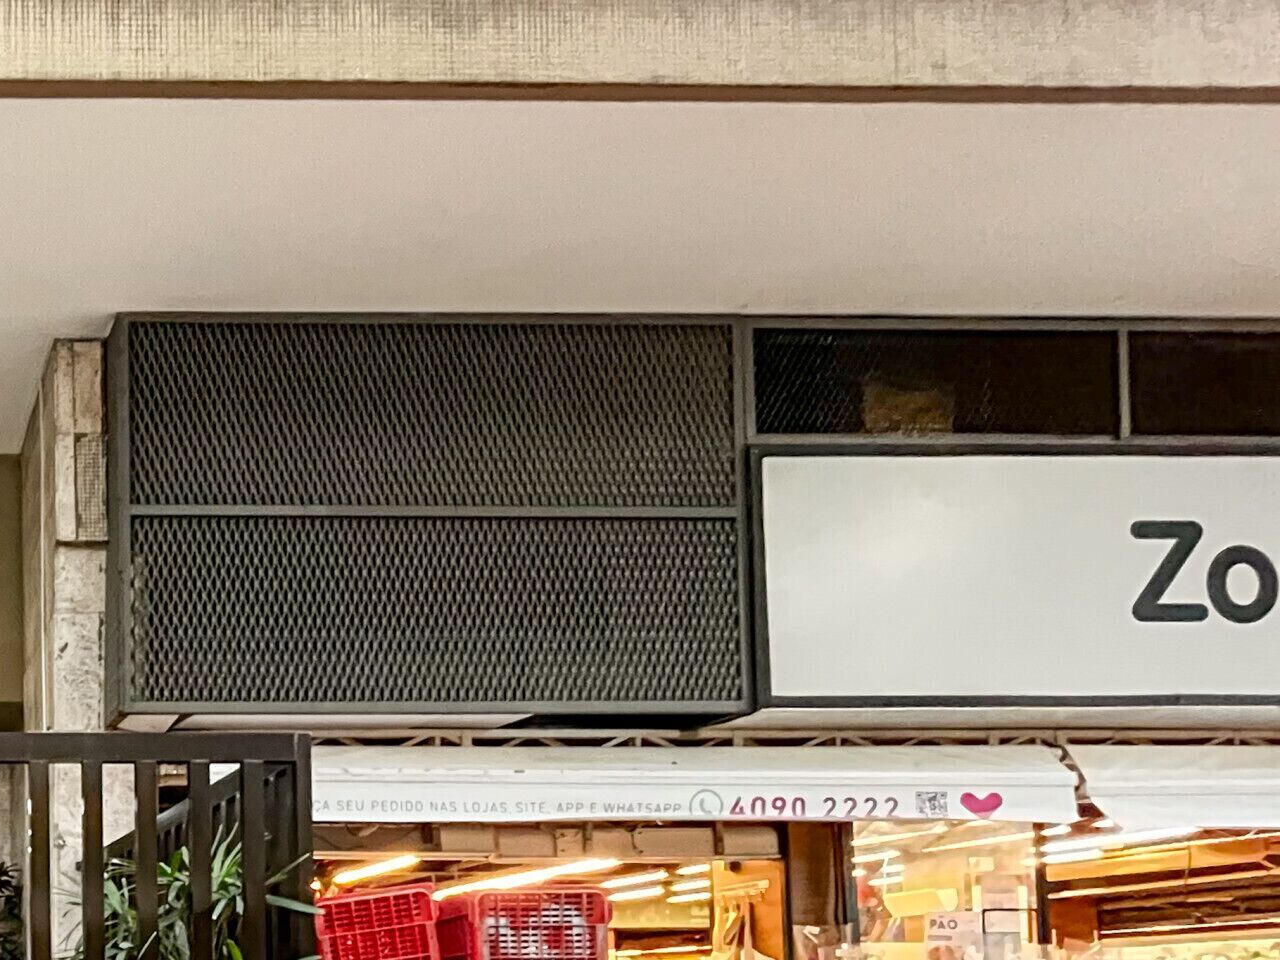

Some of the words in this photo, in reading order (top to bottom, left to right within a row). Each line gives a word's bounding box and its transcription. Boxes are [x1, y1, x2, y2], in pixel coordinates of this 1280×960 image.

[1130, 520, 1279, 624] Zo
[337, 800, 364, 811] SEU
[371, 800, 423, 812] PEDIDO
[430, 801, 457, 812] NAS
[557, 802, 583, 813] APP
[590, 802, 597, 813] E
[603, 802, 682, 813] WHATSAPP
[729, 796, 806, 816] 4090
[823, 797, 899, 818] 2222
